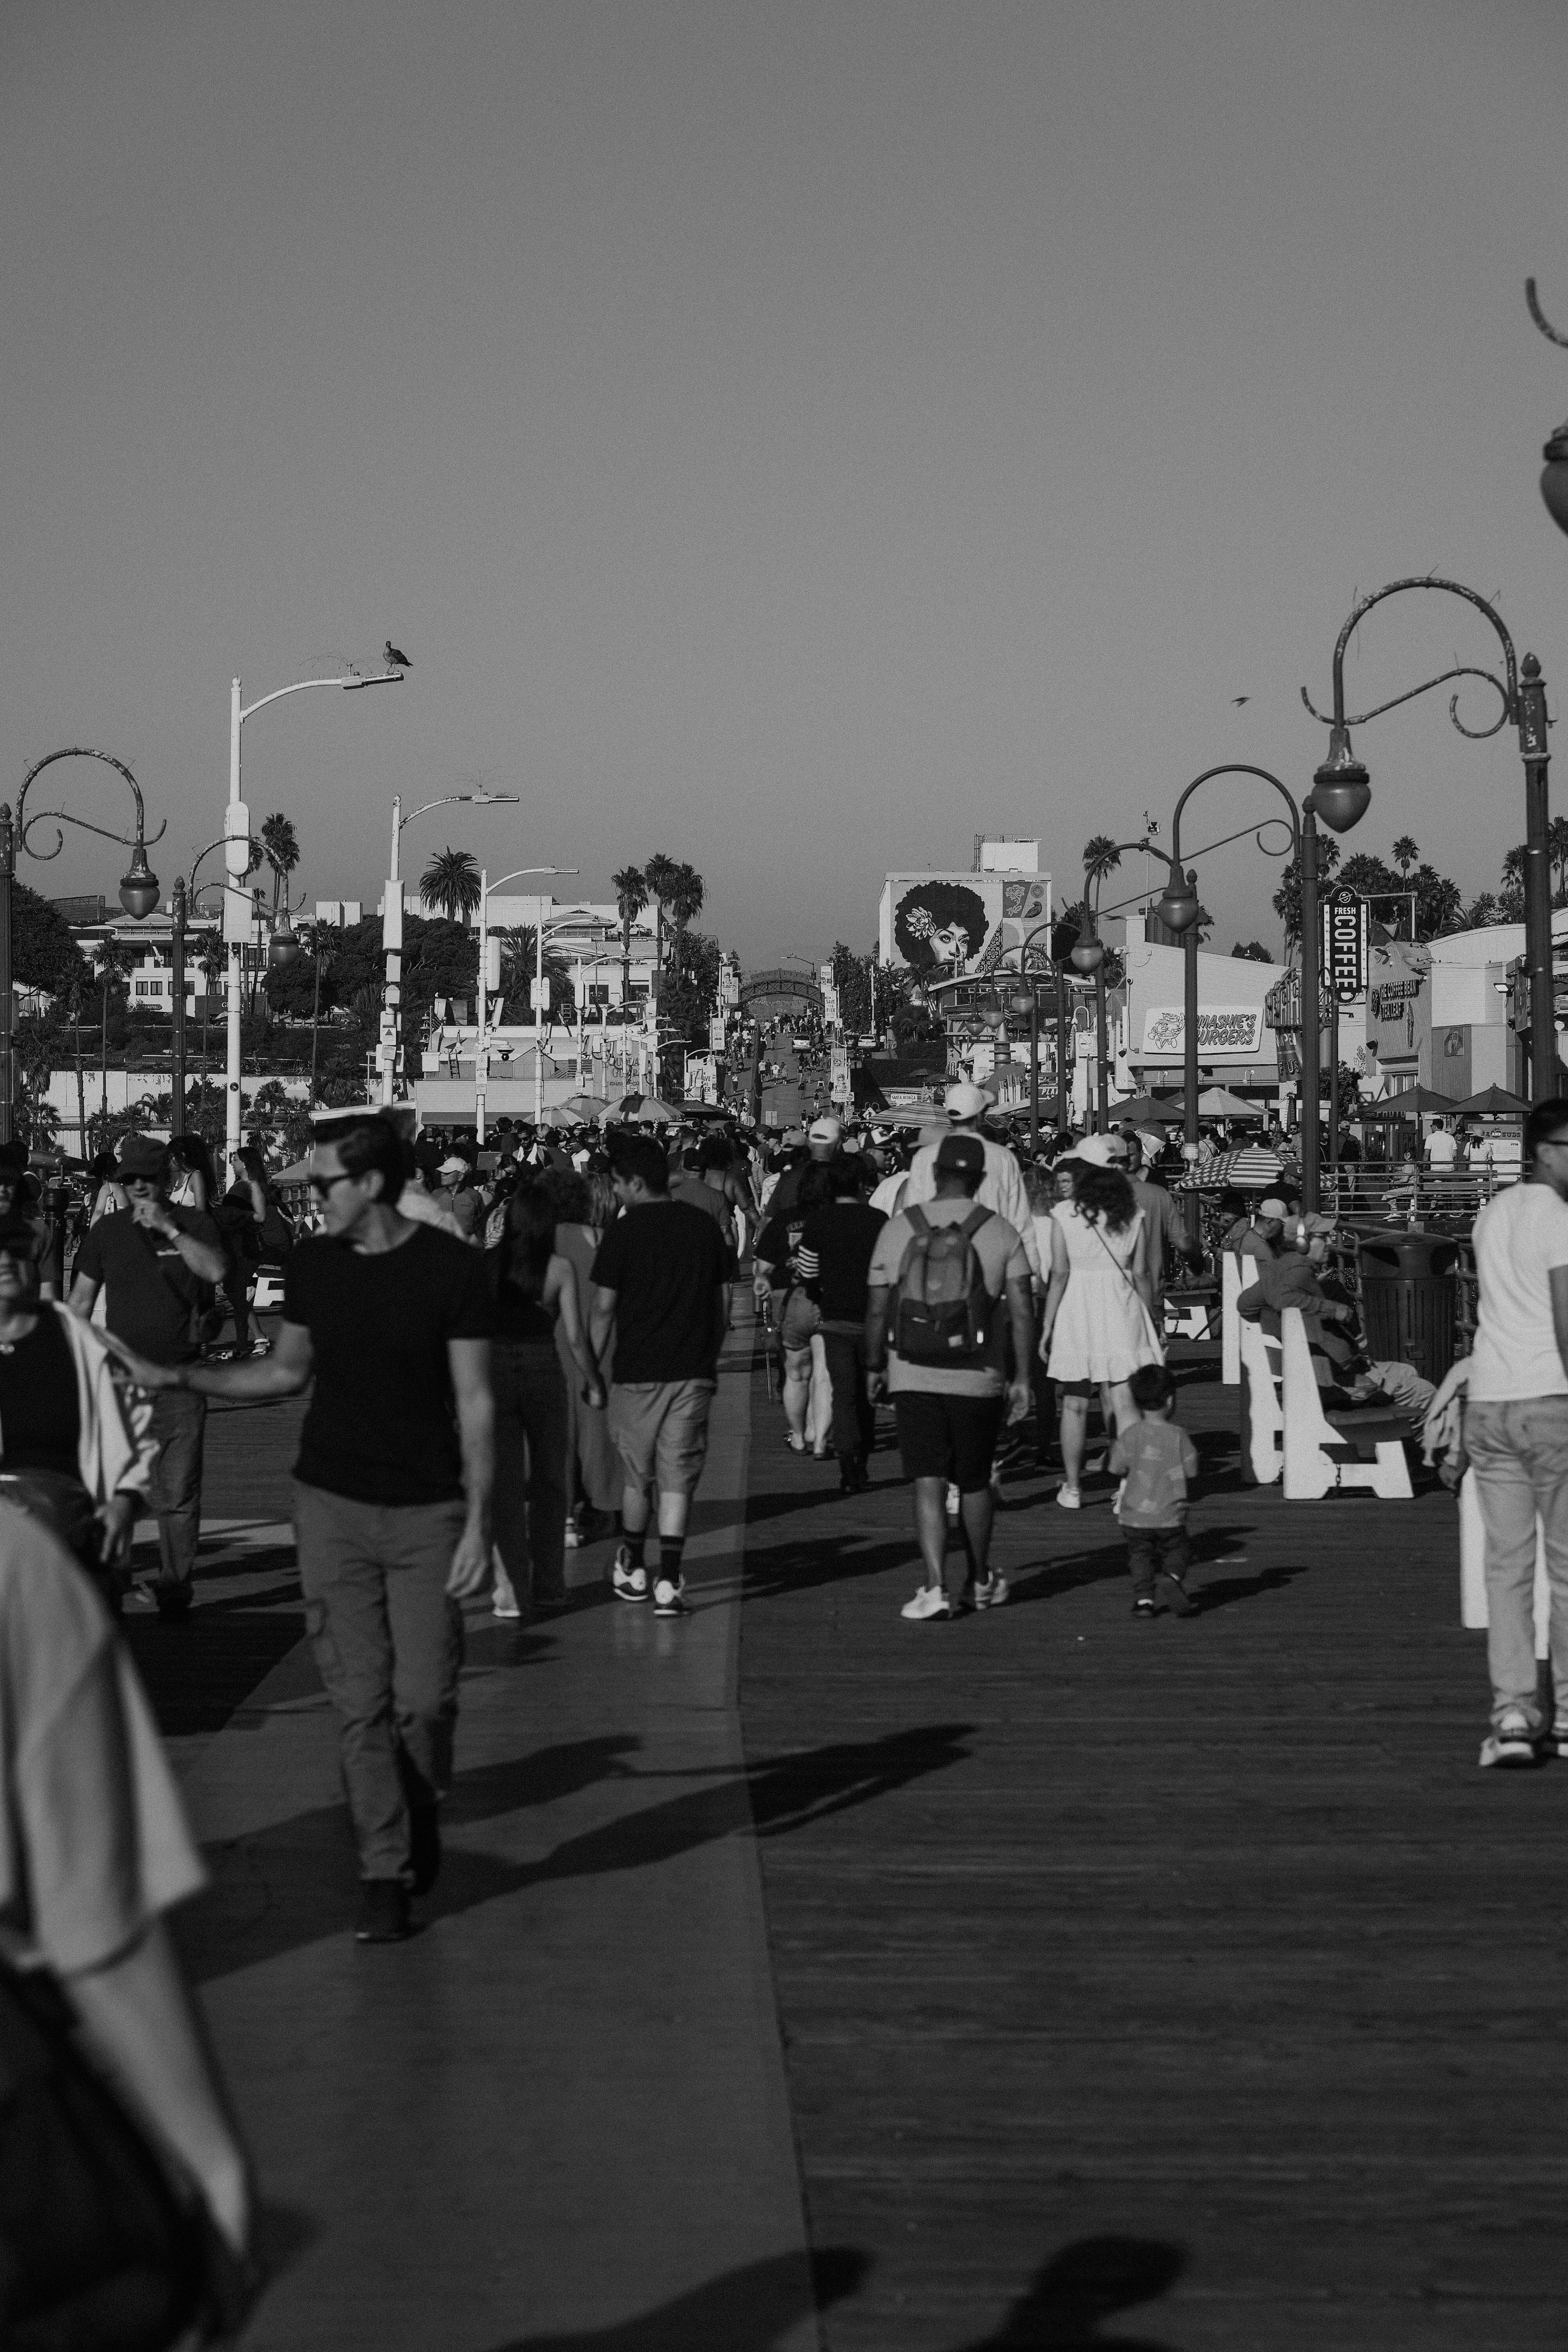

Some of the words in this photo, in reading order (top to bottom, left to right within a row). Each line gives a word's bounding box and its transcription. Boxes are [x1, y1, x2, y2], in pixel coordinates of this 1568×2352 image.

[1334, 916, 1356, 988] COFFEE
[1379, 984, 1387, 998] THE
[1388, 981, 1403, 997] COFFEE
[1404, 979, 1416, 995] BEAN
[1382, 1004, 1390, 1018] TEA
[1391, 1002, 1402, 1017] LEAF
[1197, 1014, 1256, 1029] MASHIE'S
[1197, 1029, 1255, 1045] URGERS
